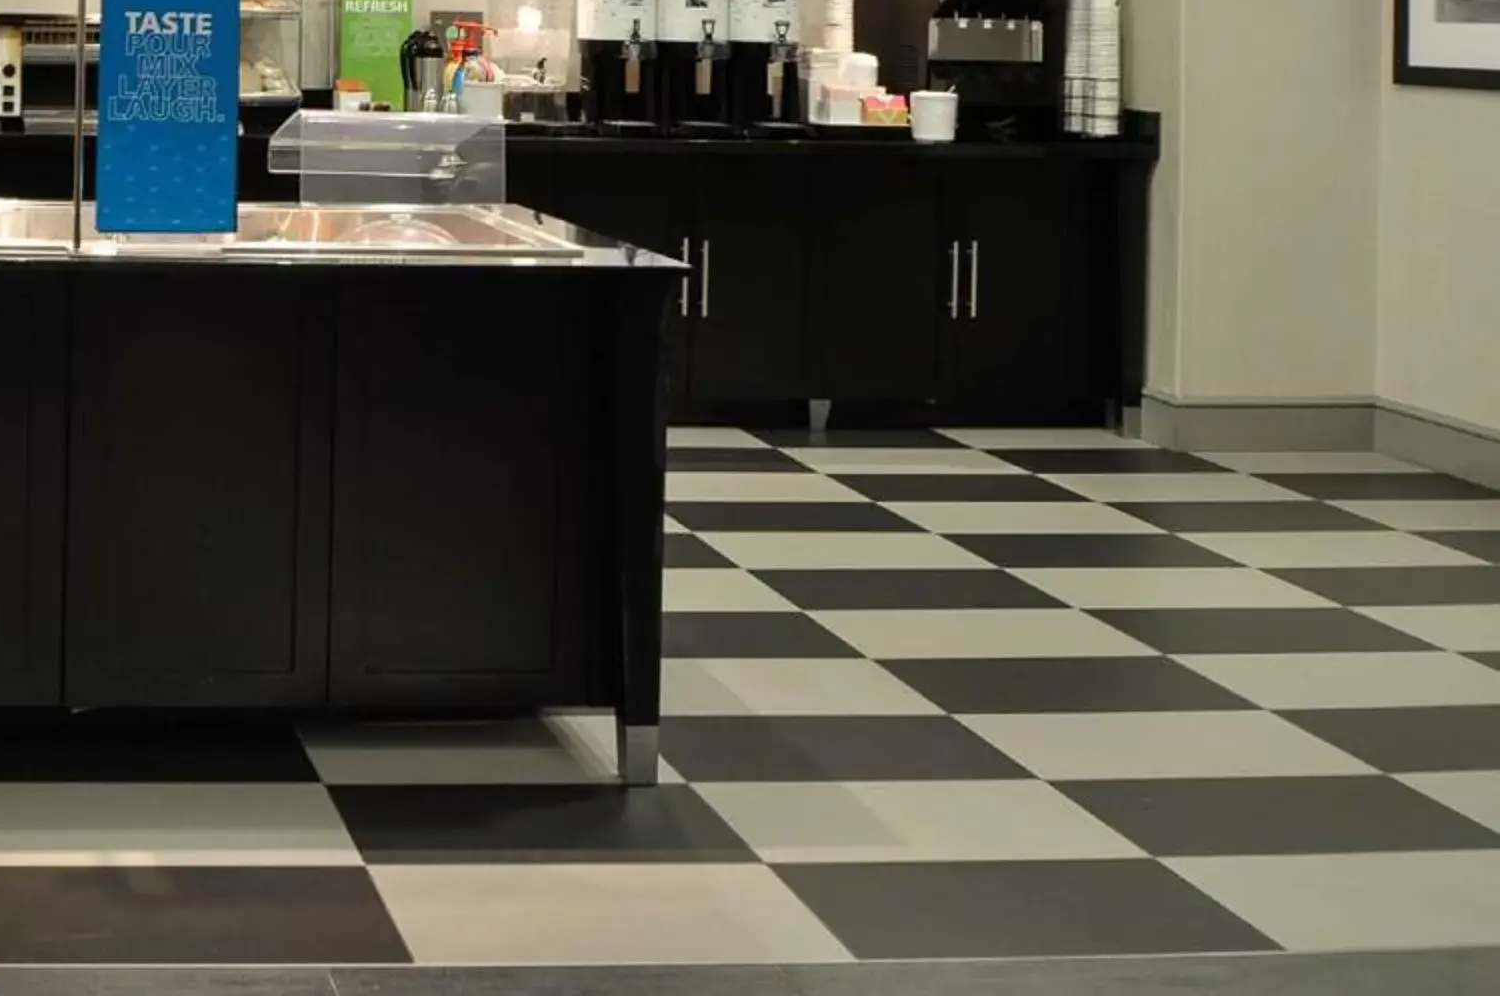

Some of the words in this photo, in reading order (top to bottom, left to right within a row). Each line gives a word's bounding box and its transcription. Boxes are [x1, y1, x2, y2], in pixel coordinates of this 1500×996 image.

[344, 0, 409, 13] REFRESH
[124, 11, 213, 35] TASTE
[124, 31, 213, 58] POUR
[136, 53, 199, 79] MIX
[117, 74, 218, 100] LAYER
[107, 95, 226, 123] LAUGH.
